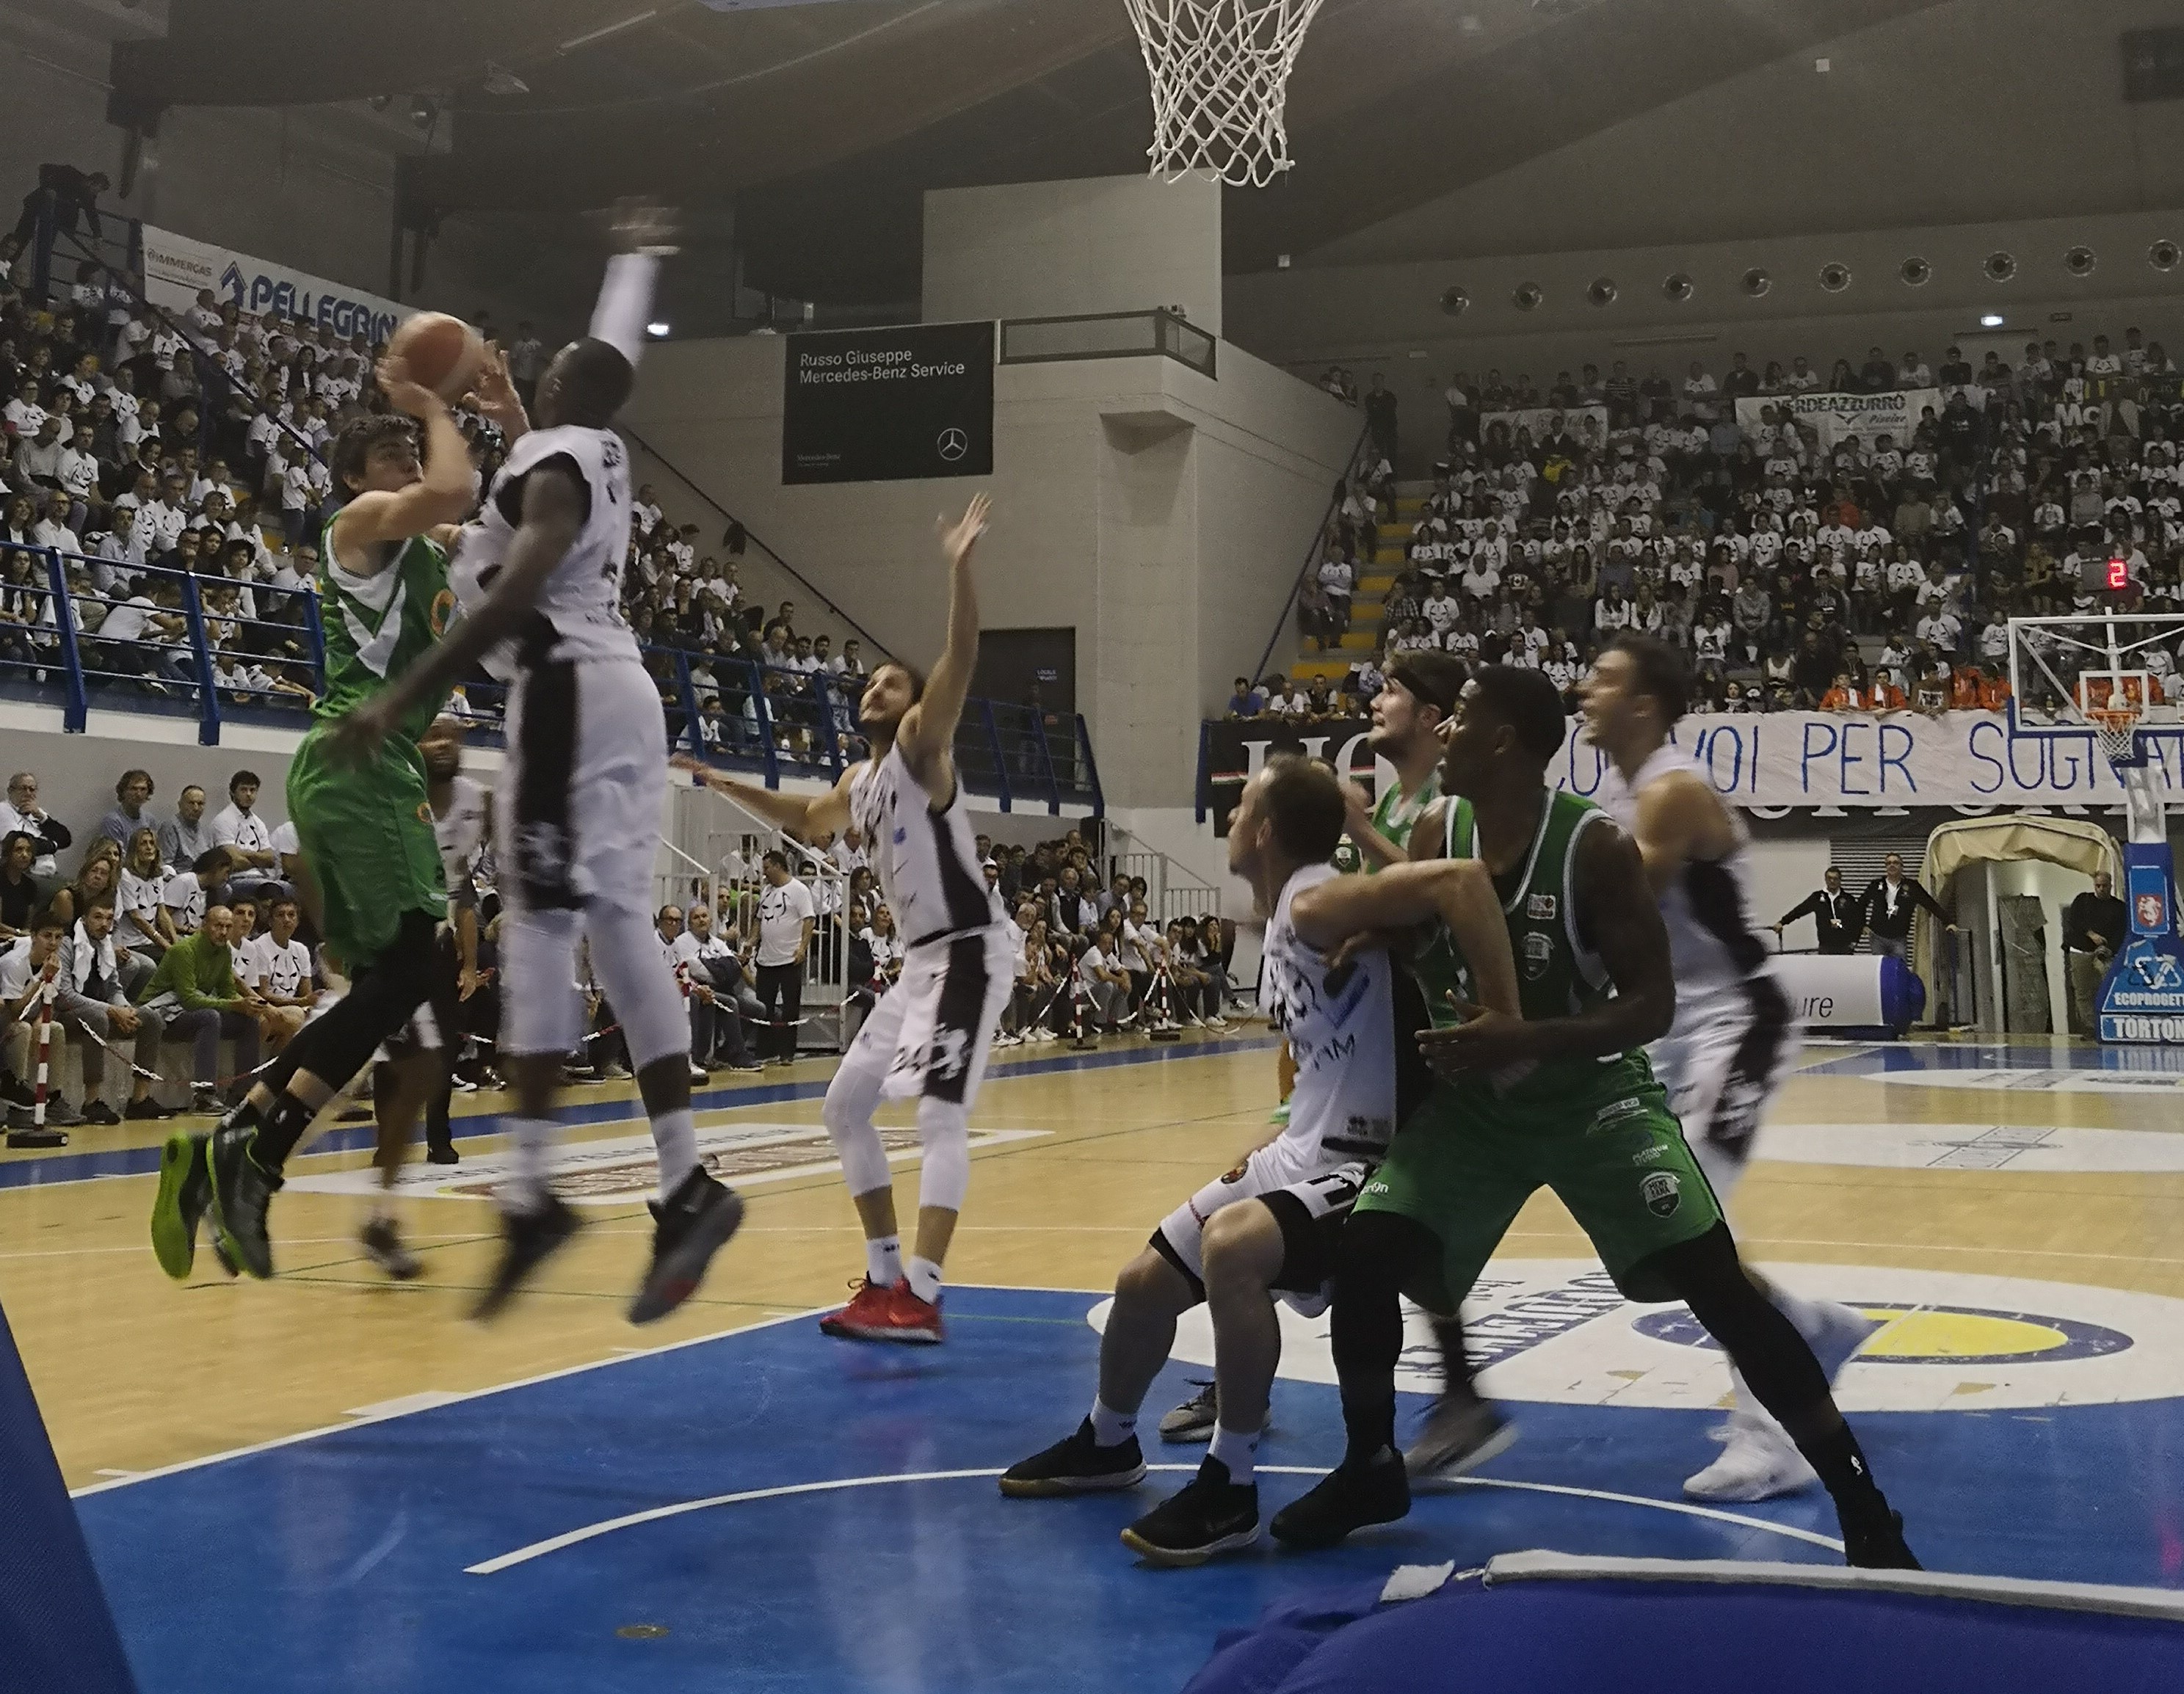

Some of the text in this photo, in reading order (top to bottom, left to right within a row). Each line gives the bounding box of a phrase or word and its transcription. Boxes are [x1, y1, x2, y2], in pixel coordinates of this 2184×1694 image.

[800, 349, 912, 366] Russo Giuseppe
[799, 362, 965, 383] Mercedes-Benz Service
[2110, 562, 2126, 587] 2
[1802, 722, 1918, 795] PER
